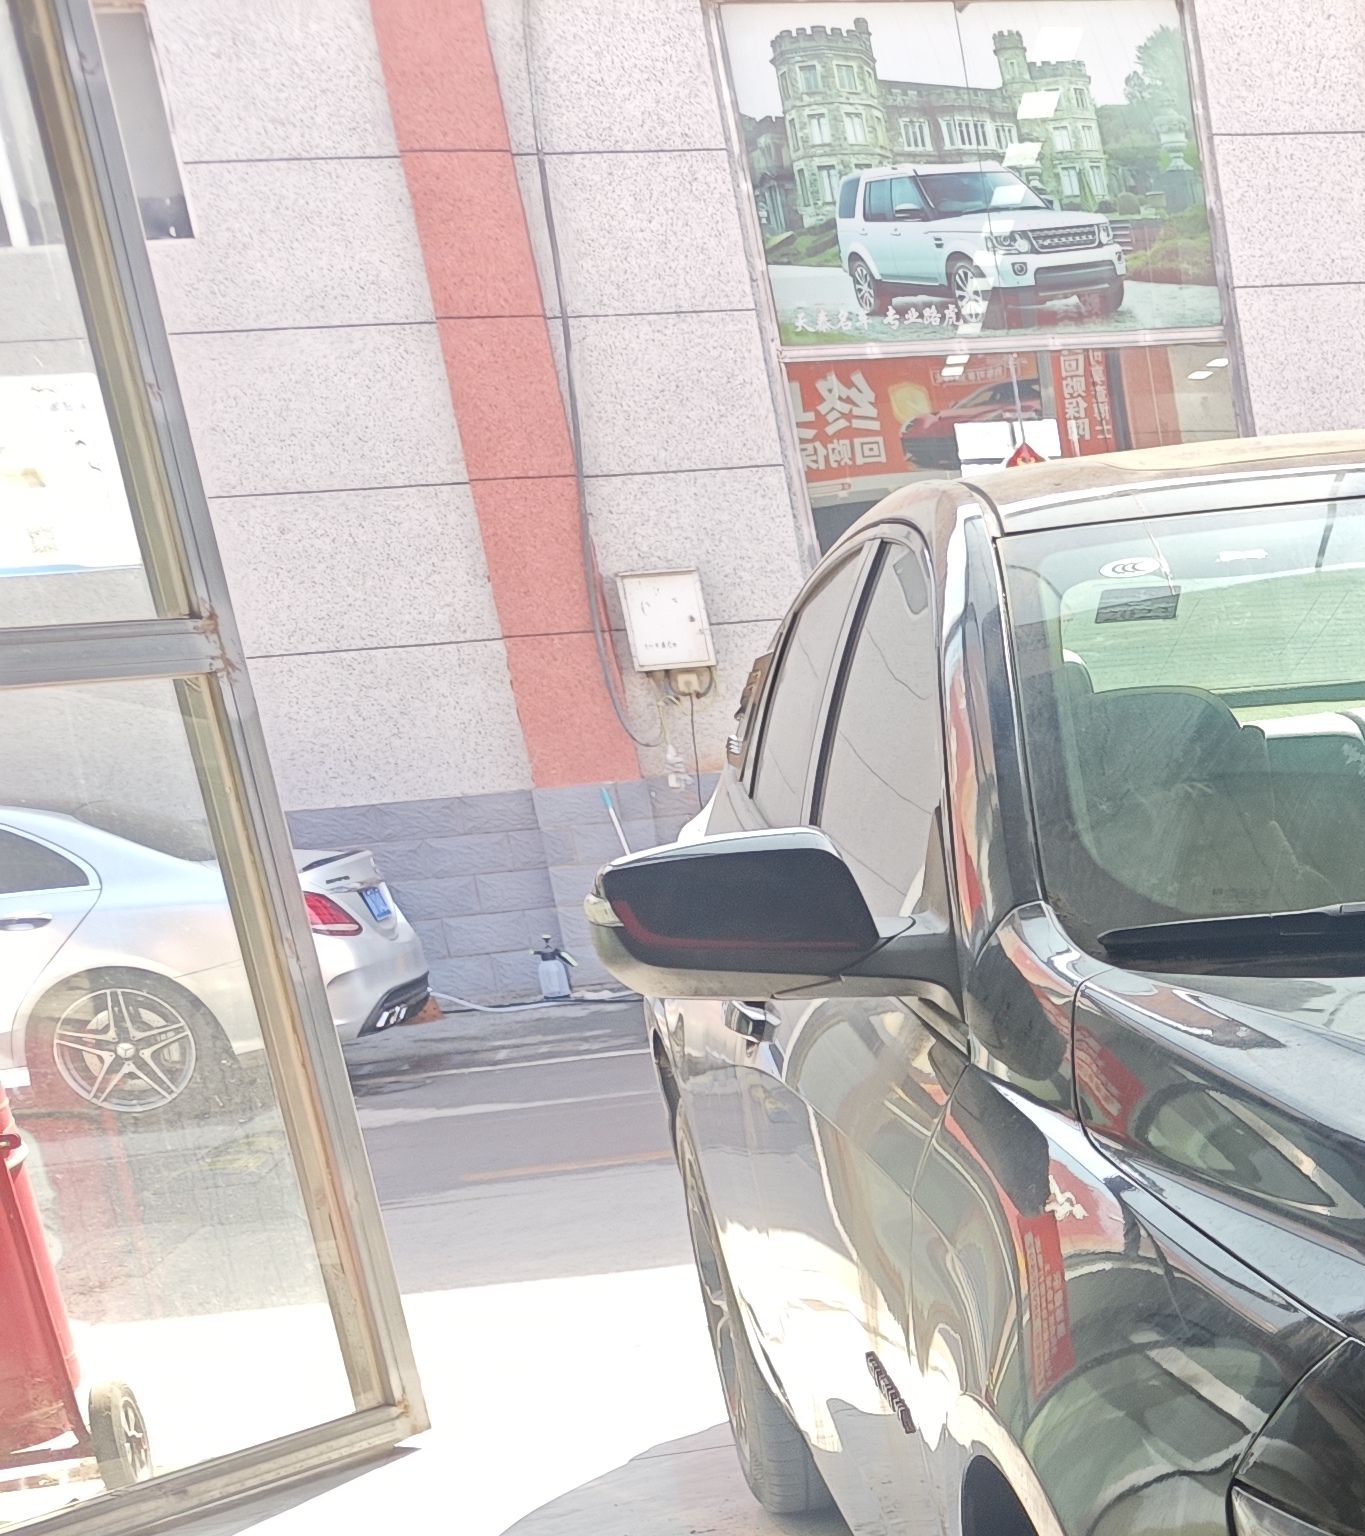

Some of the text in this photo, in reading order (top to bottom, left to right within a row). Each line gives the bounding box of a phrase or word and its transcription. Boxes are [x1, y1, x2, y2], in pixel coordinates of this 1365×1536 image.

[794, 304, 963, 333] 天泰名车 专业路虎
